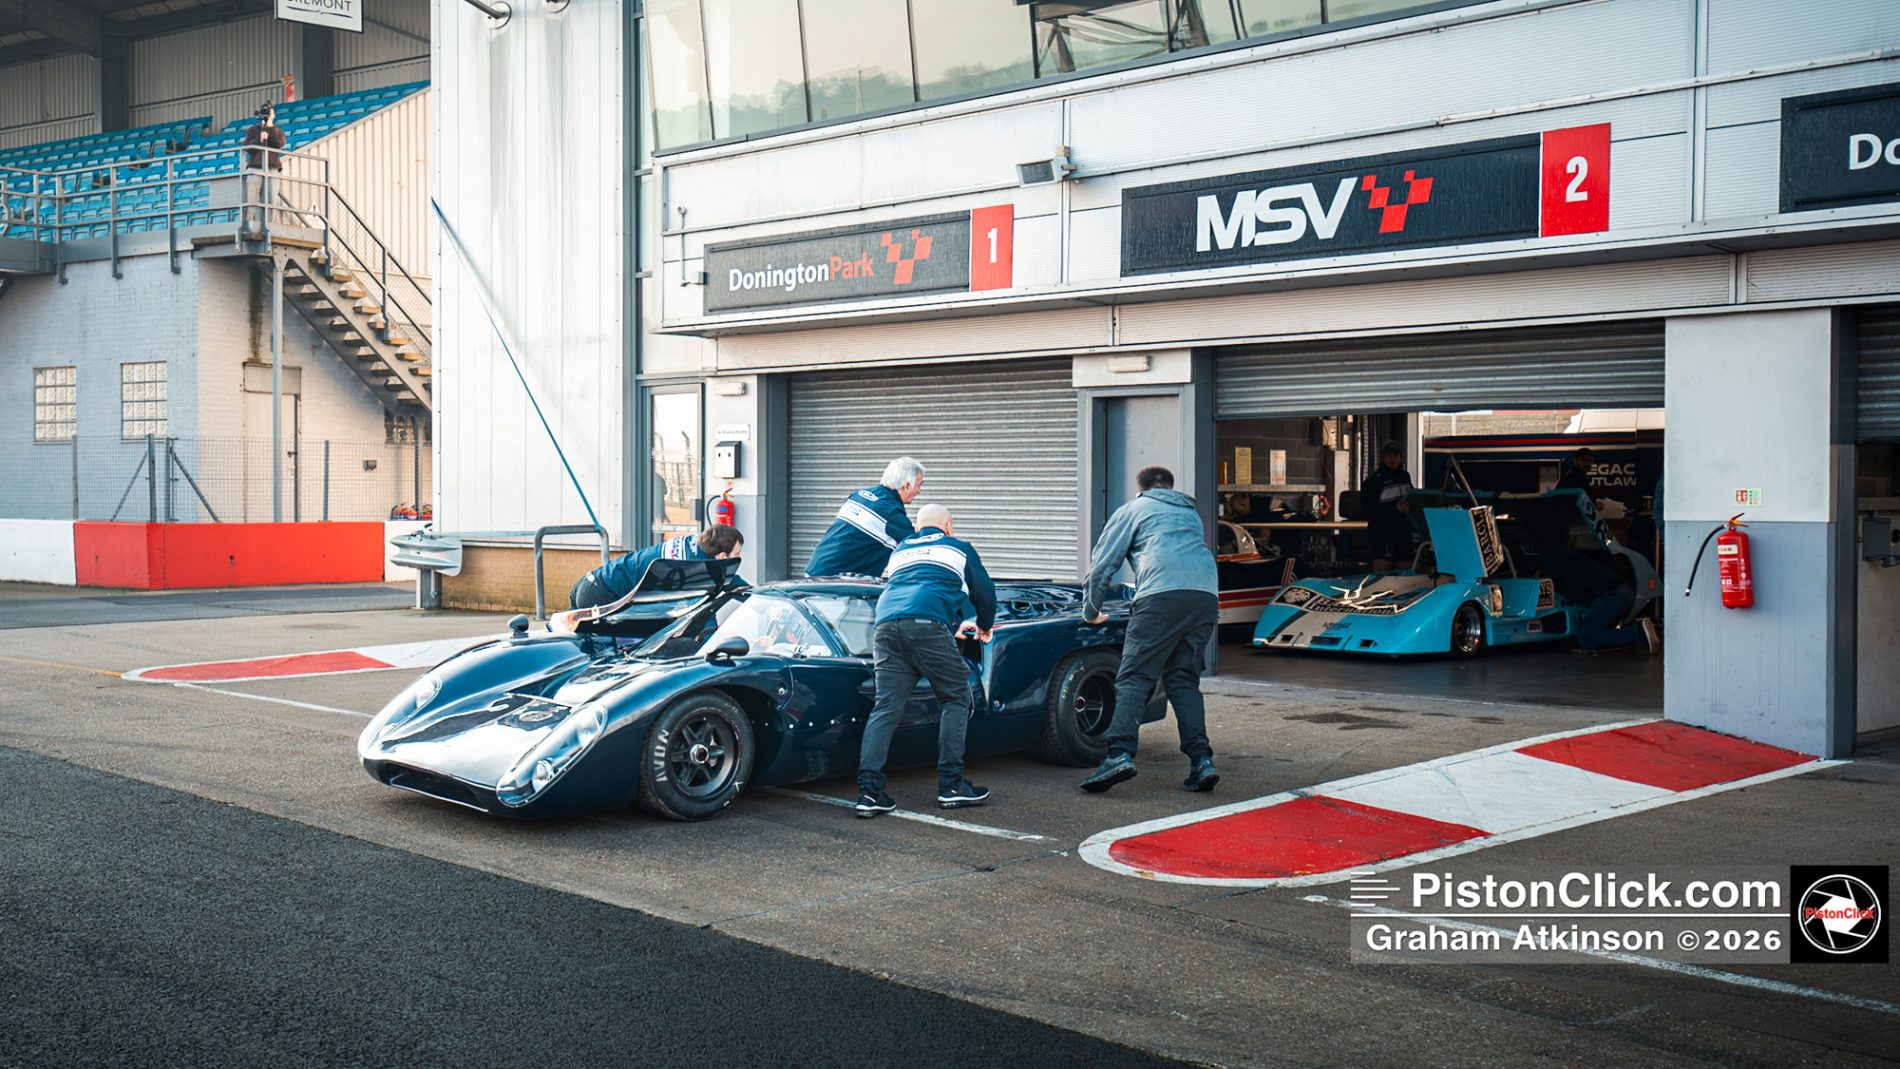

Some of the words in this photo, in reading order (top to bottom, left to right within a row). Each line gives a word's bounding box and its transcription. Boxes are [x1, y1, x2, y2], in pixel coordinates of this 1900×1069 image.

[288, 0, 352, 11] MONT
[1565, 155, 1588, 203] 2
[1196, 177, 1358, 252] MSV
[987, 227, 998, 264] 1
[653, 729, 670, 782] AVON
